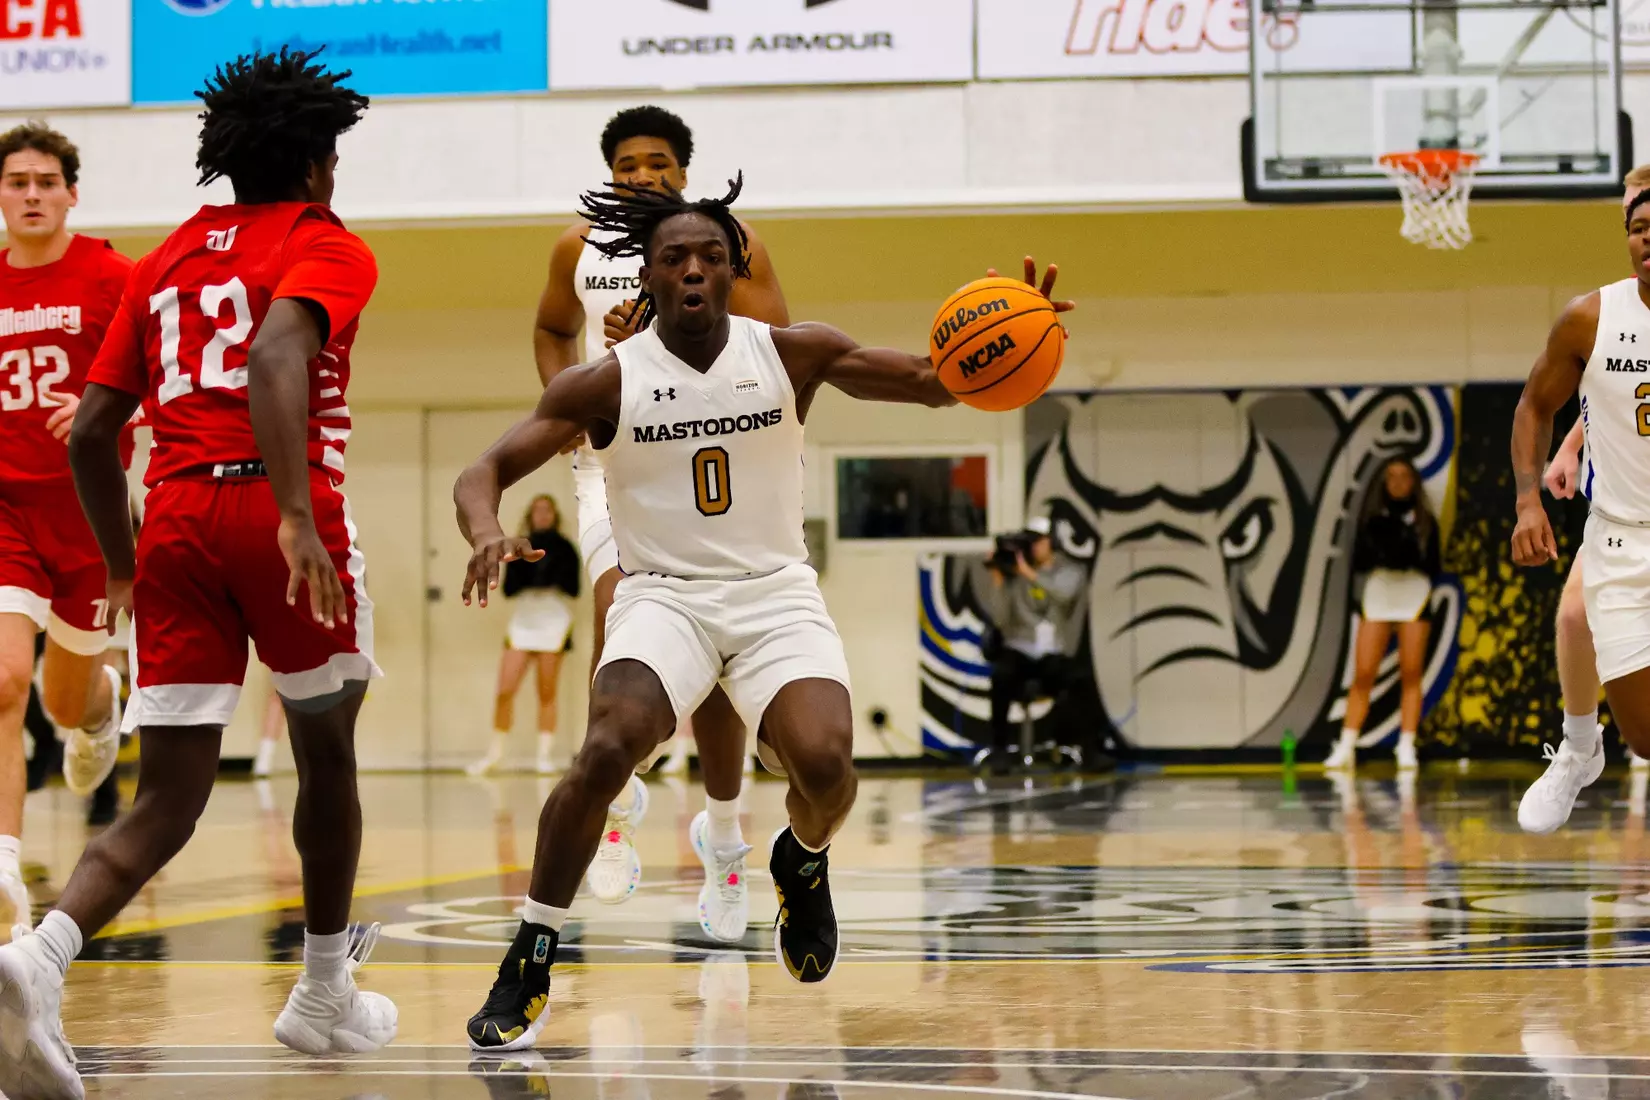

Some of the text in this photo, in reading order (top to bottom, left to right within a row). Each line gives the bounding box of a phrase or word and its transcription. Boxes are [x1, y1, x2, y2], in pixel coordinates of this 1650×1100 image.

[621, 32, 893, 55] UNDER ARMOUR
[585, 276, 642, 290] MASTO
[149, 276, 254, 406] 12
[933, 297, 1012, 350] Wilson
[0, 345, 71, 412] 32
[957, 332, 1017, 379] NCAA
[1605, 357, 1650, 373] MAS
[633, 407, 782, 443] MASTODONS
[691, 445, 733, 517] 0
